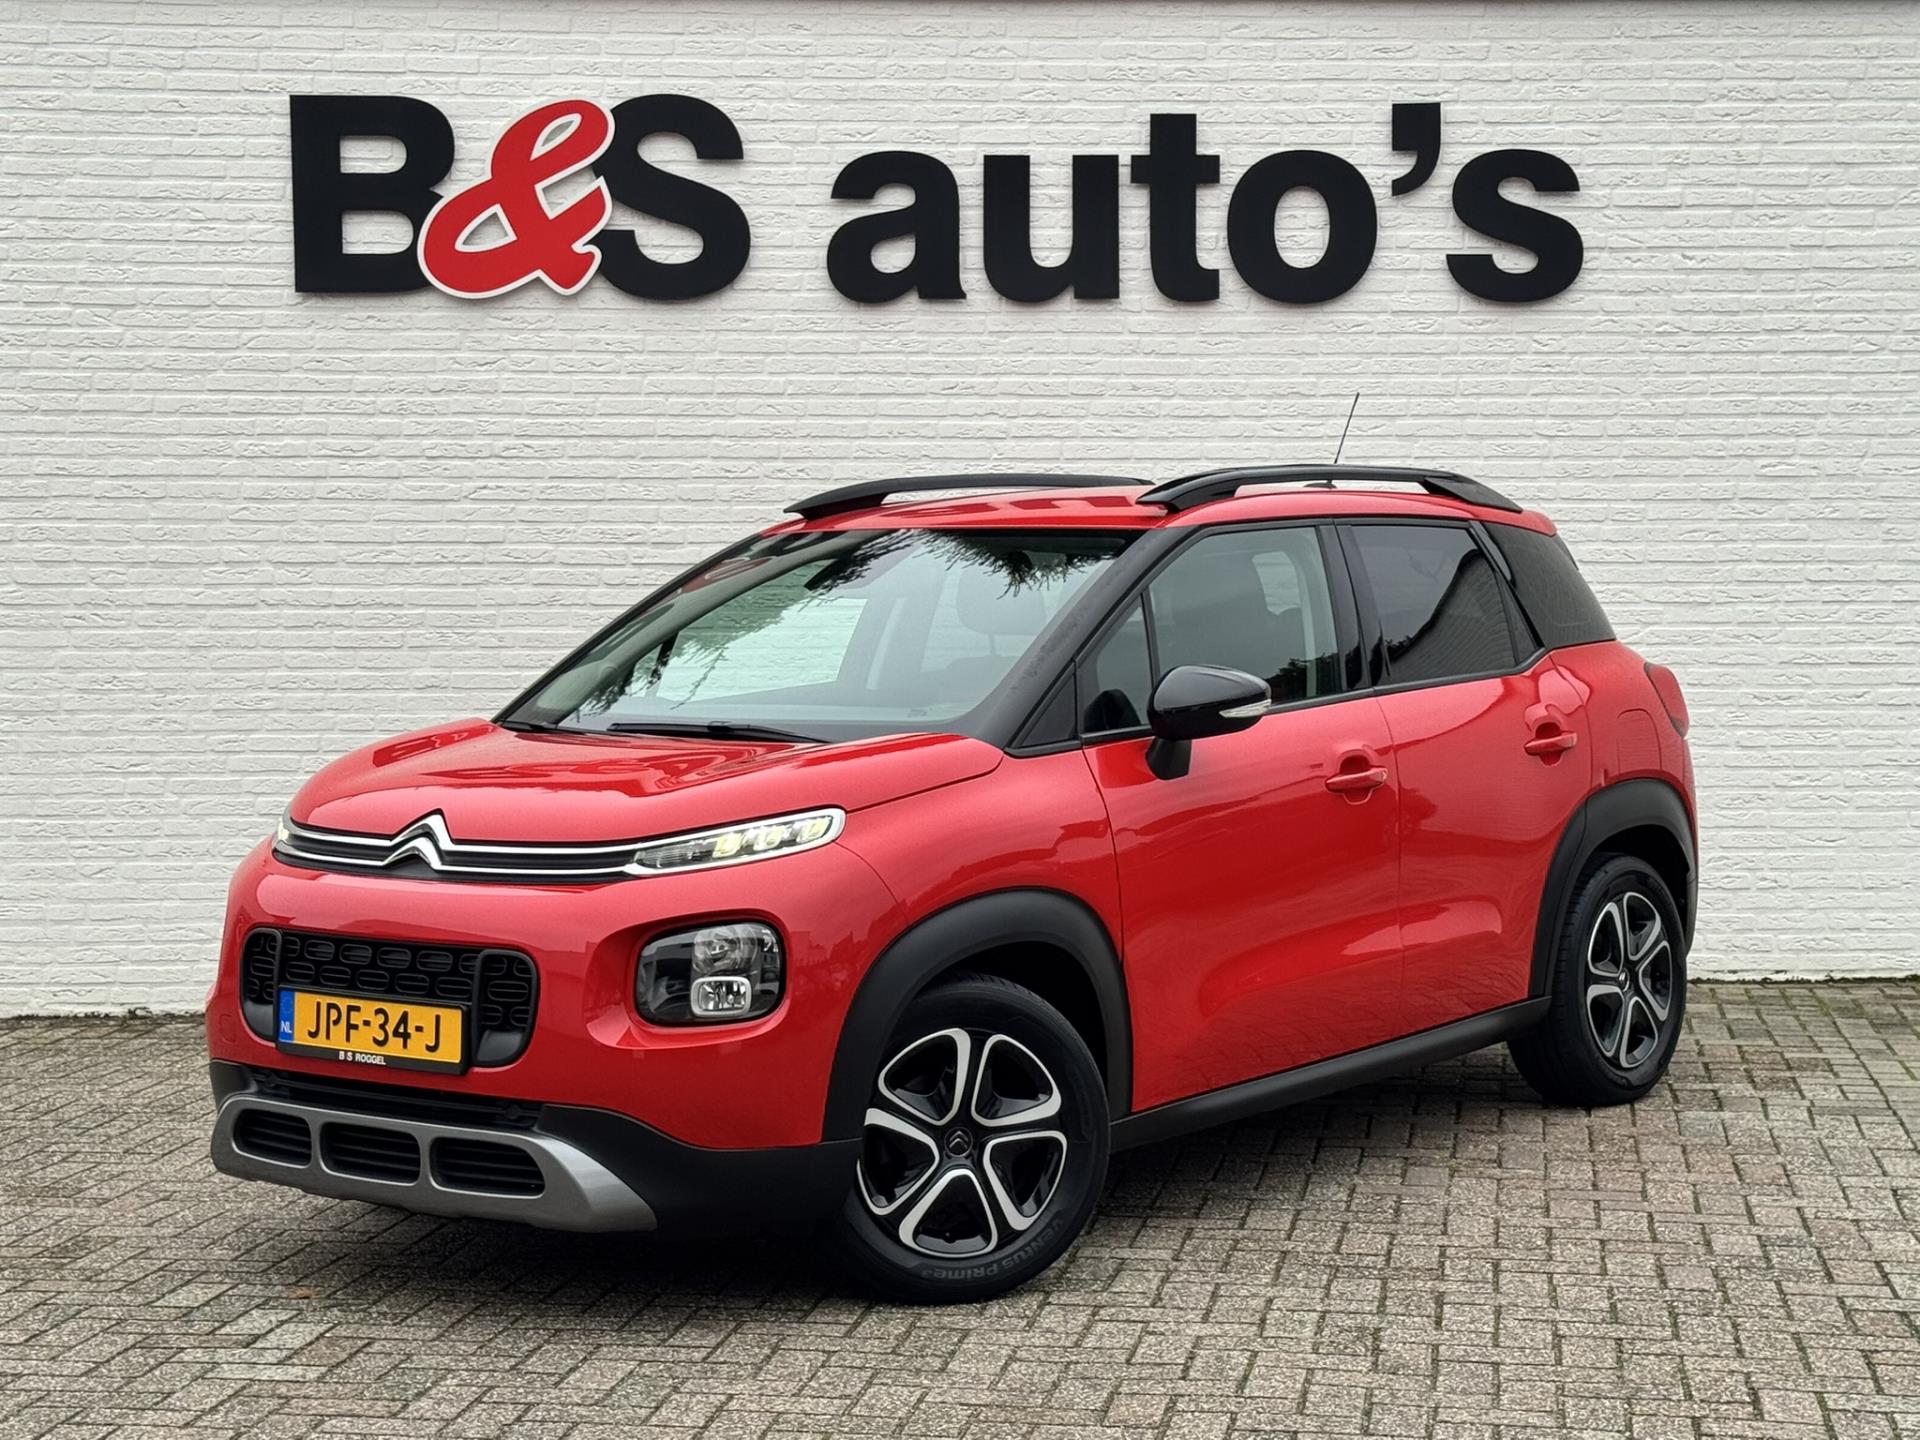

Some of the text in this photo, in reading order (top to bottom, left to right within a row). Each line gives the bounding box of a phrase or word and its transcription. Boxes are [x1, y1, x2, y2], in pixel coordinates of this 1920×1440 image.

[290, 93, 1585, 307] B&S auto's
[280, 1020, 293, 1034] NL
[307, 1000, 441, 1053] JPF-34-J
[355, 1052, 387, 1066] ROGGEL
